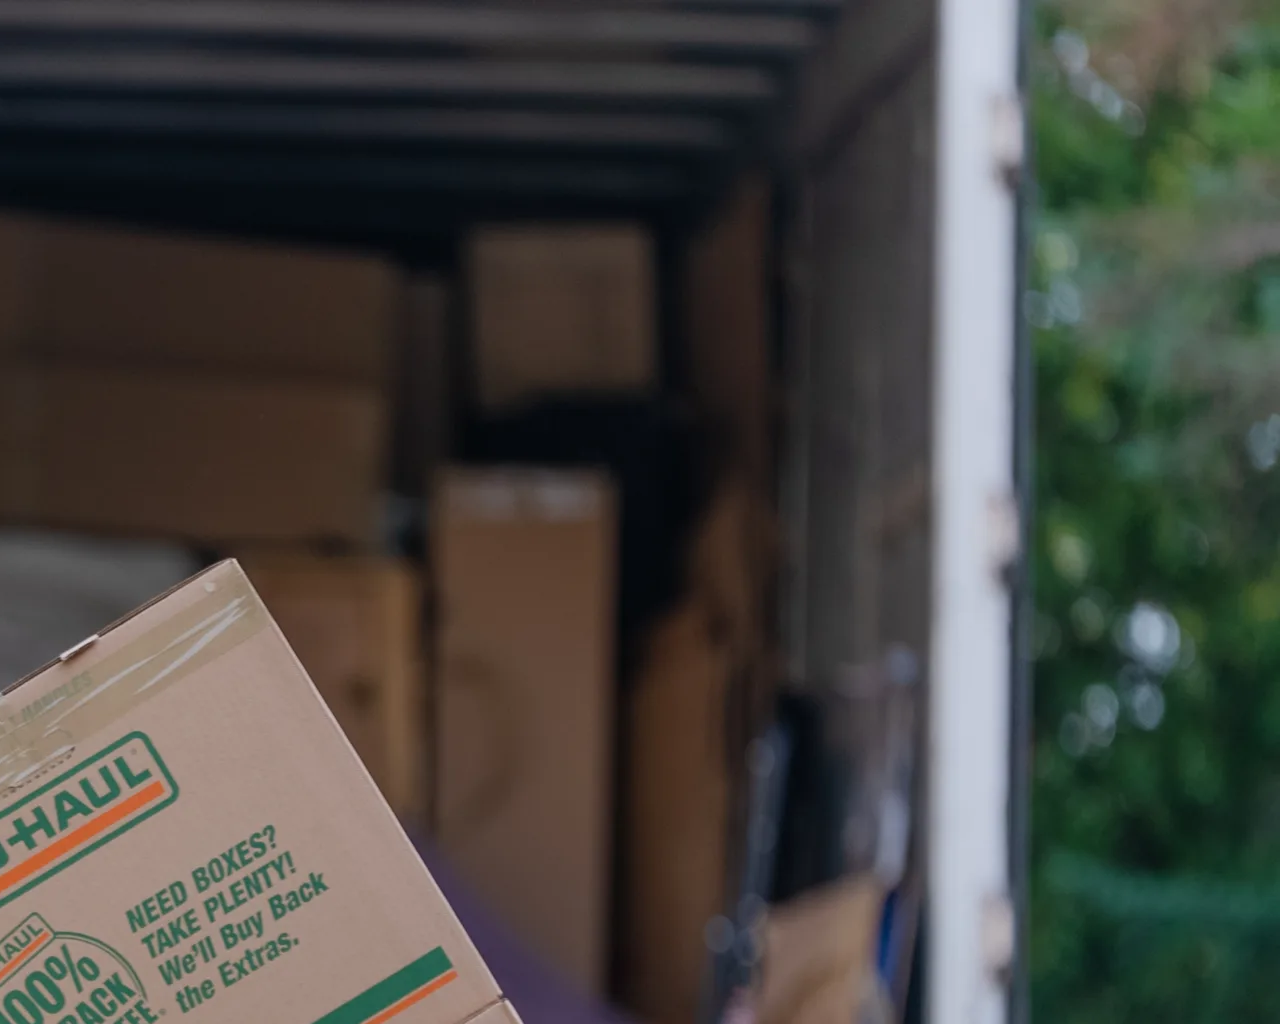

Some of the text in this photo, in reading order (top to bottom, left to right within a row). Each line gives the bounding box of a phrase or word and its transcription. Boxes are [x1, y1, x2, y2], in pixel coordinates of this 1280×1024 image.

[125, 824, 277, 933] NEED BOXES?
[141, 851, 297, 958] TAKE PLENTY!
[158, 872, 330, 986] We'll Buy Back
[175, 932, 300, 1014] the Extras.
